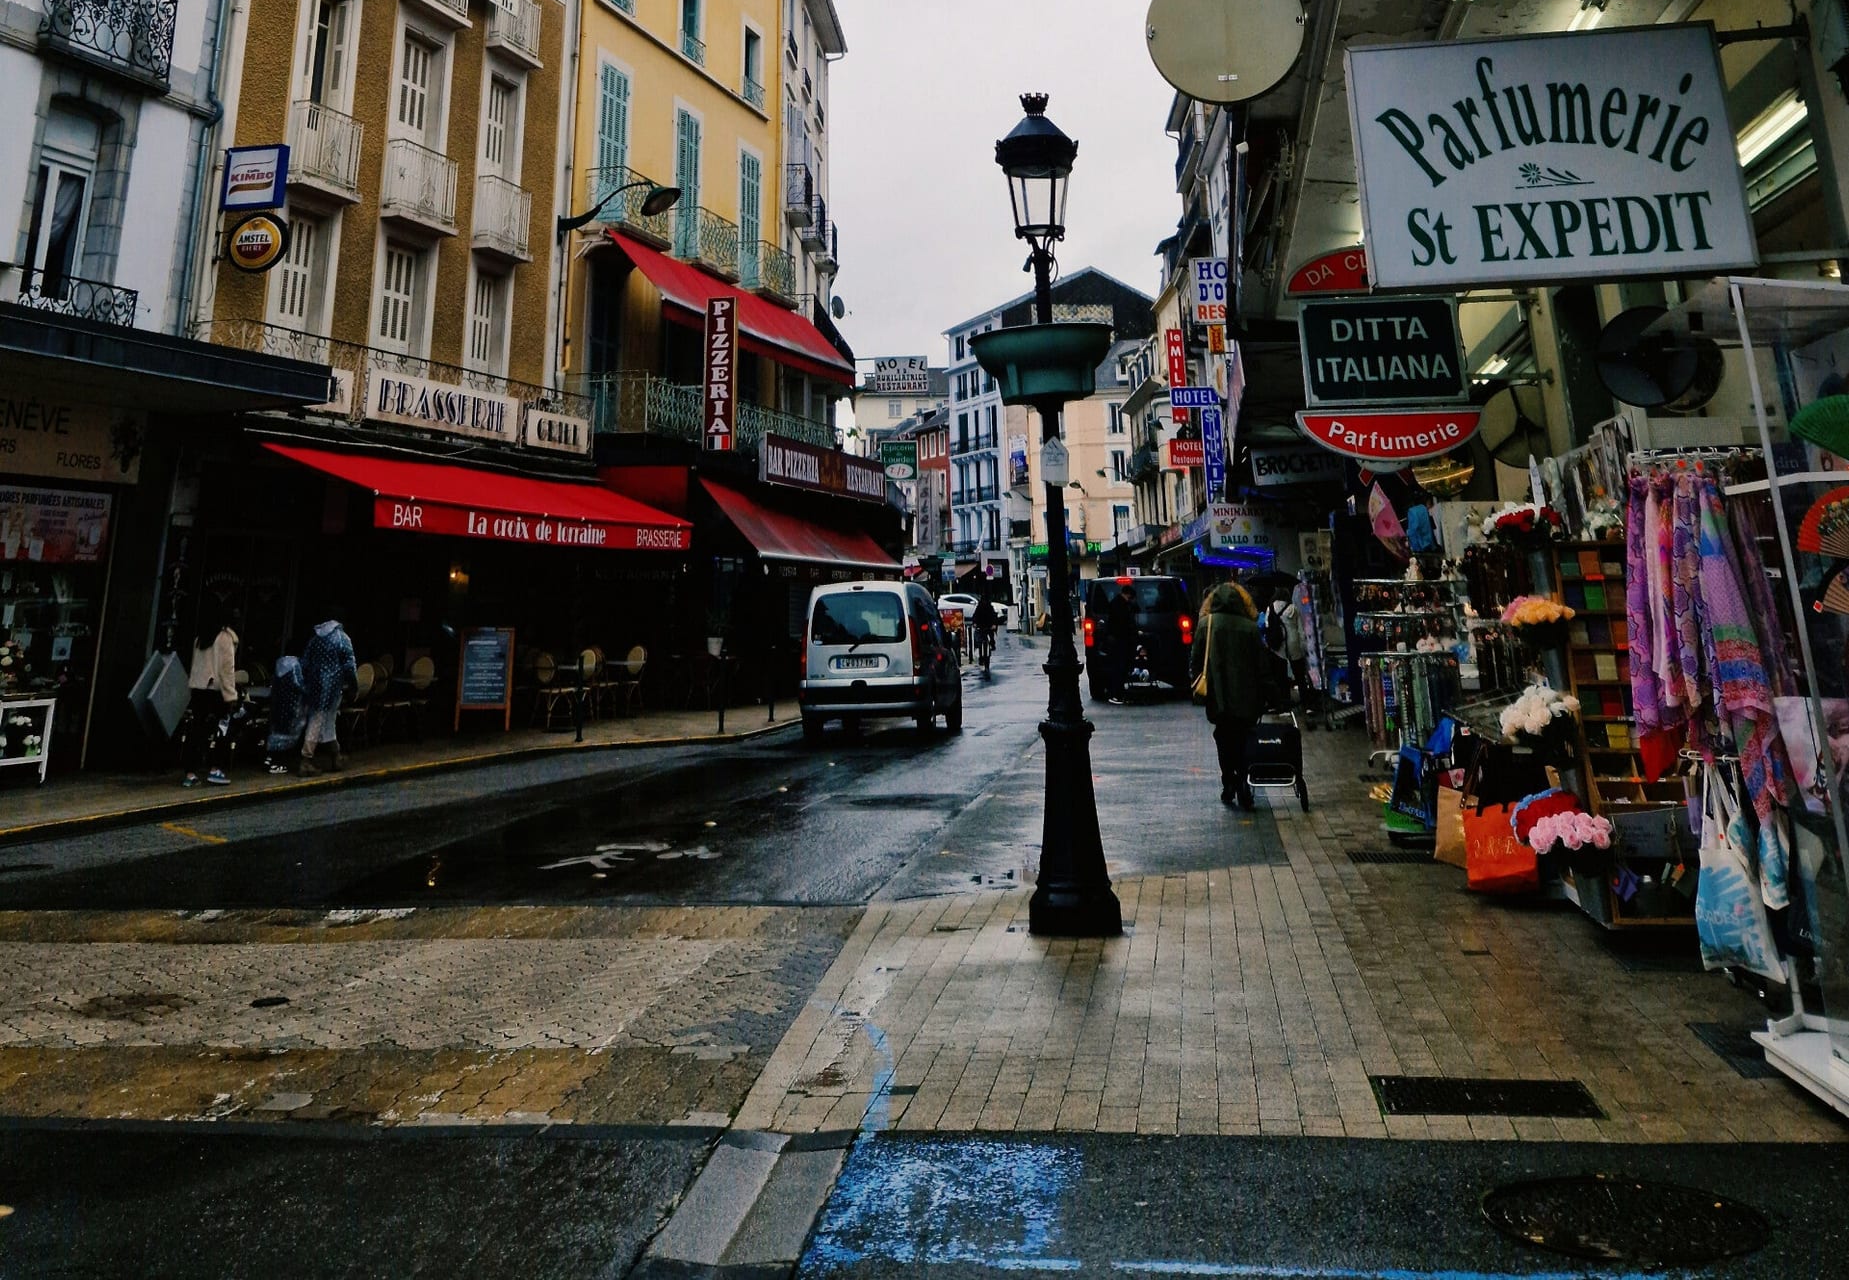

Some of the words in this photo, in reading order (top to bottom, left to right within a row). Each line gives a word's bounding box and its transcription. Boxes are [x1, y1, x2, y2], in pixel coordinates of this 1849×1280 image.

[1375, 56, 1710, 188] Parfumerie
[231, 172, 275, 182] KIMBO
[239, 234, 270, 244] AMSTEL
[1408, 208, 1458, 267] St
[1472, 190, 1712, 263] EXPEDIT
[1306, 263, 1336, 286] DA
[1170, 331, 1181, 342] le
[1331, 316, 1429, 343] DITTA
[707, 300, 731, 433] PIZZERIA
[1316, 353, 1452, 384] ITALIANA
[877, 382, 928, 391] RESTAURANT
[1174, 390, 1216, 405] HOTEL
[378, 377, 507, 432] BRASSERIE
[1175, 441, 1203, 452] HOTEL
[1328, 420, 1460, 451] Parfumerie
[56, 452, 101, 470] FLORES
[767, 444, 784, 477] BAR
[785, 448, 820, 485] PIZZERIA
[846, 464, 885, 498] RESTAURANT
[883, 455, 915, 464] Lourdes
[393, 503, 423, 528] BAR
[467, 511, 488, 536] La
[493, 516, 530, 541] croix
[535, 521, 553, 543] de
[556, 522, 607, 546] lorraine
[636, 528, 683, 550] BRASSERIE
[1221, 535, 1249, 545] DALLO
[1253, 535, 1269, 545] ZIO
